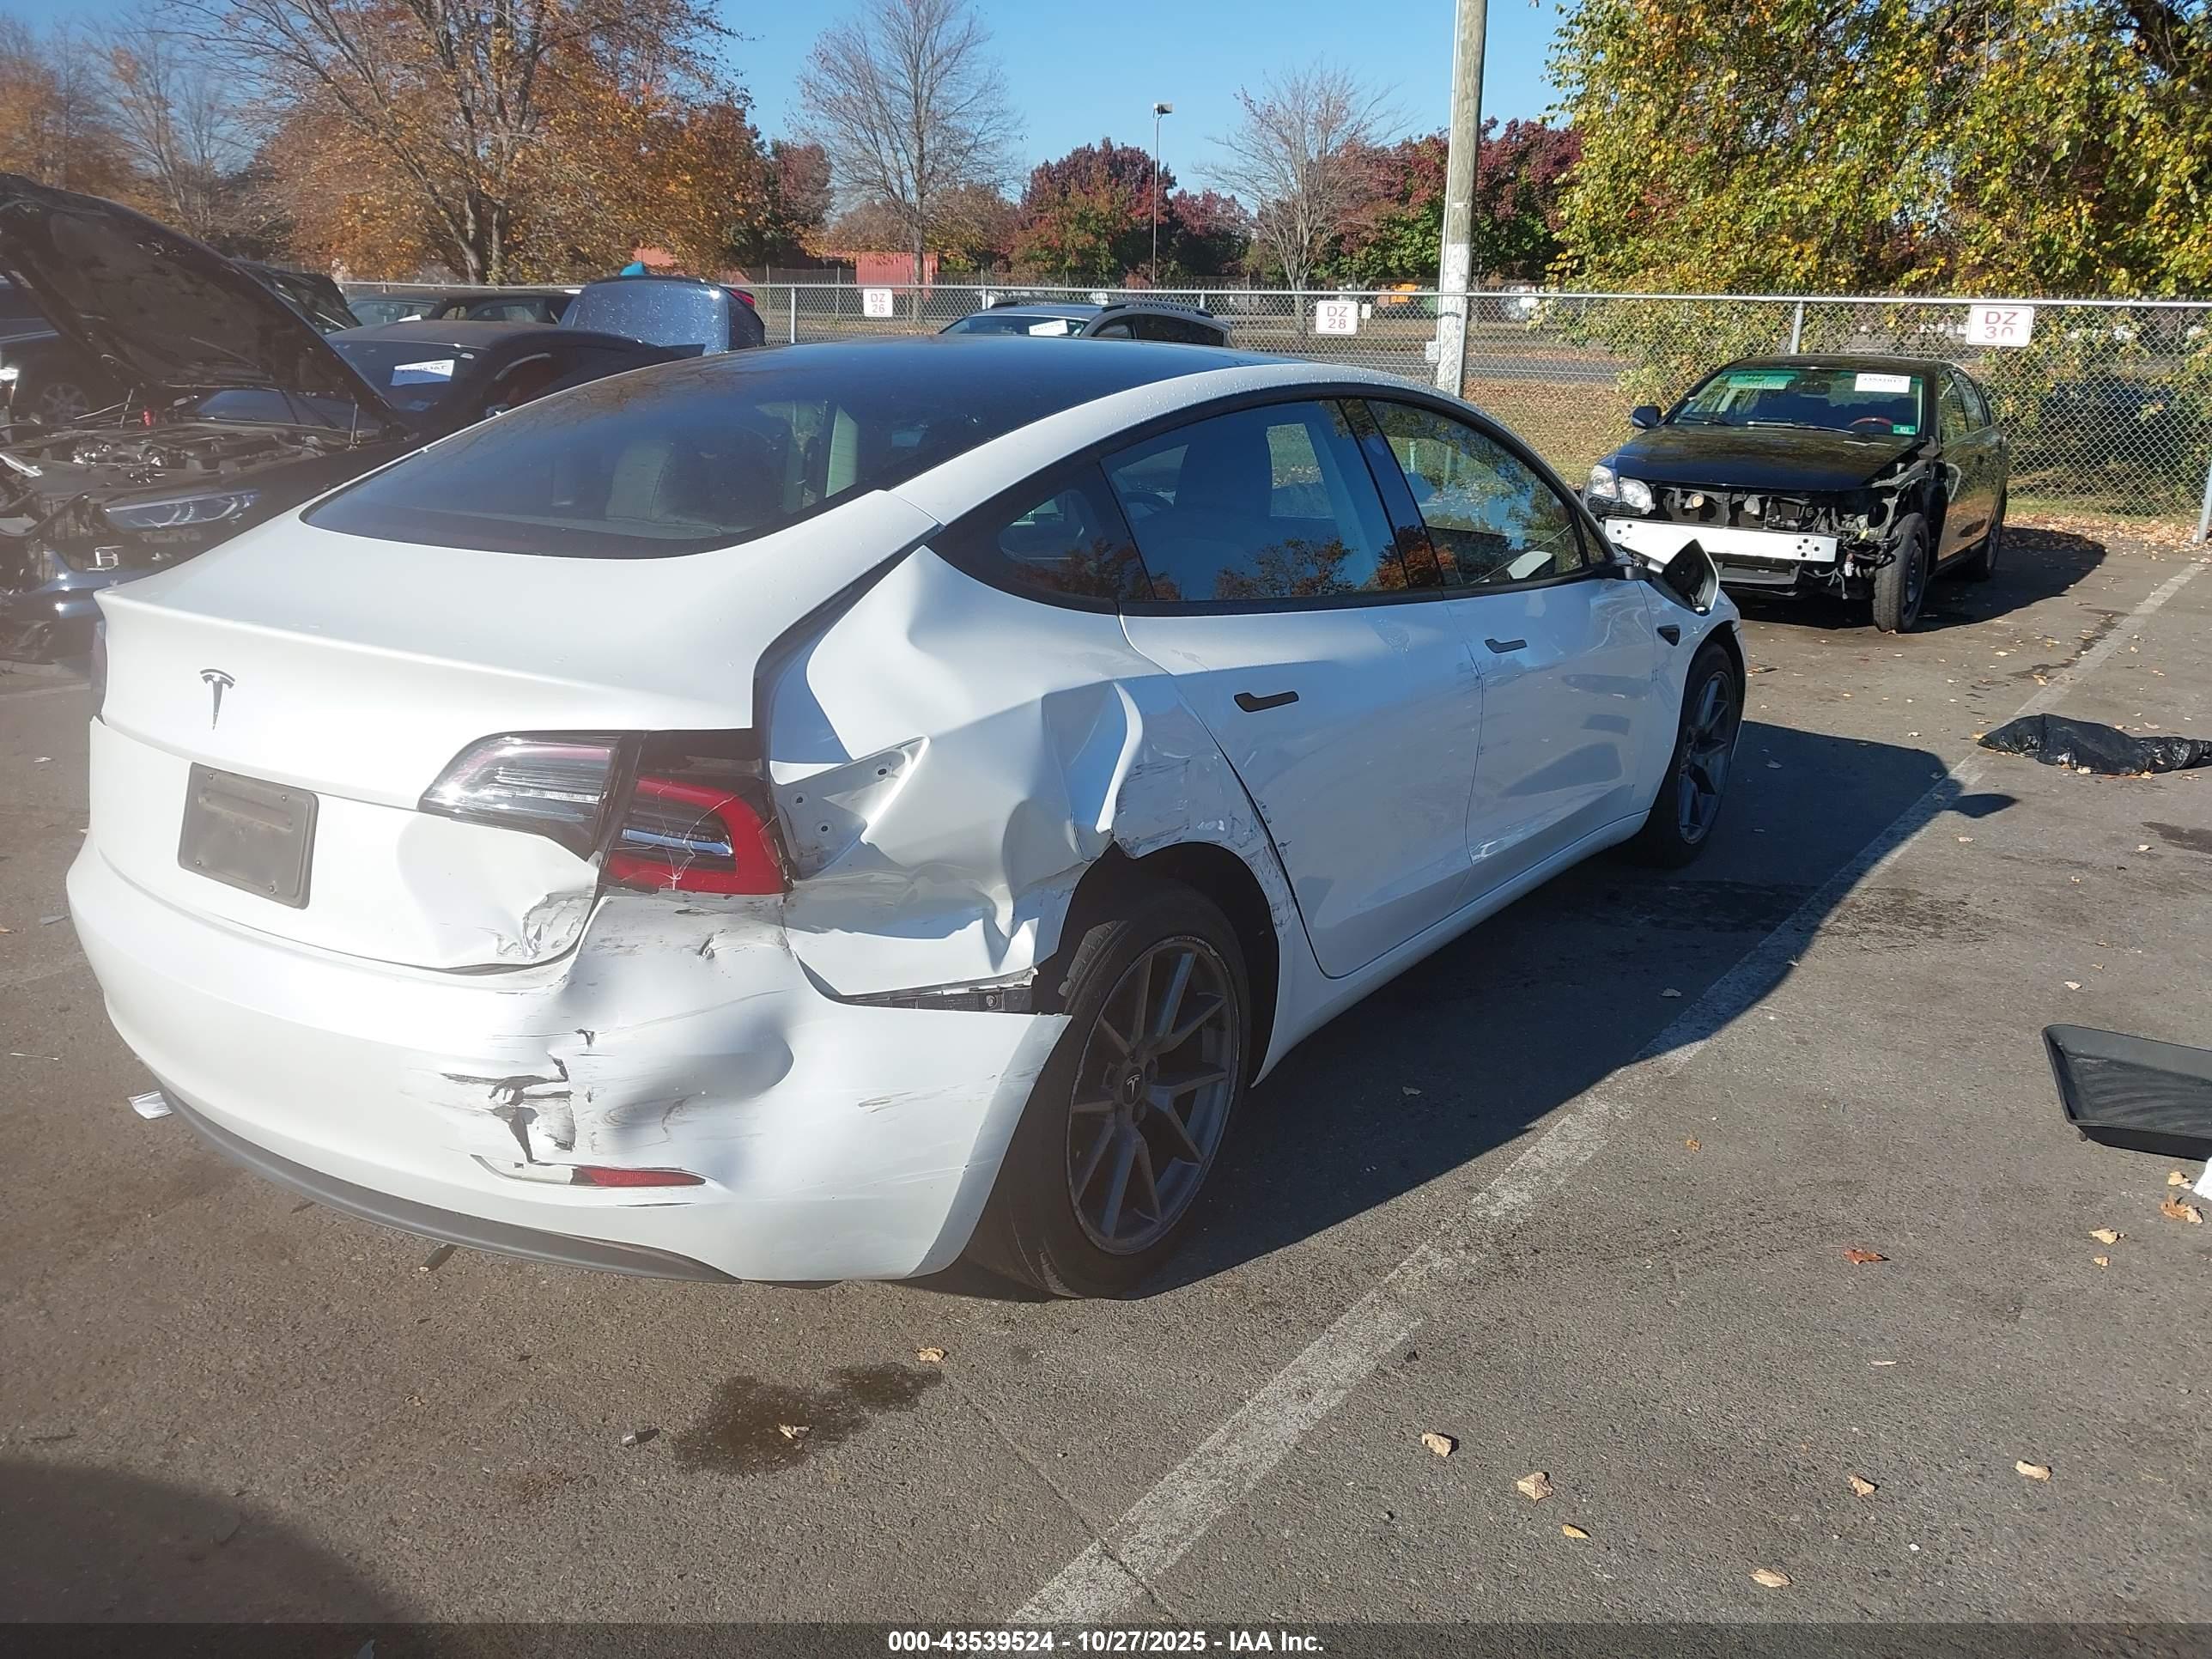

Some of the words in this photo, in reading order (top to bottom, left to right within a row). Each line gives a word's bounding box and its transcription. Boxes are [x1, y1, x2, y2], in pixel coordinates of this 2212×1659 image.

[871, 293, 885, 302] DZ
[872, 304, 884, 313] 26
[1327, 306, 1348, 318] DZ
[1328, 318, 1346, 329] 28
[1984, 311, 2019, 325] DZ
